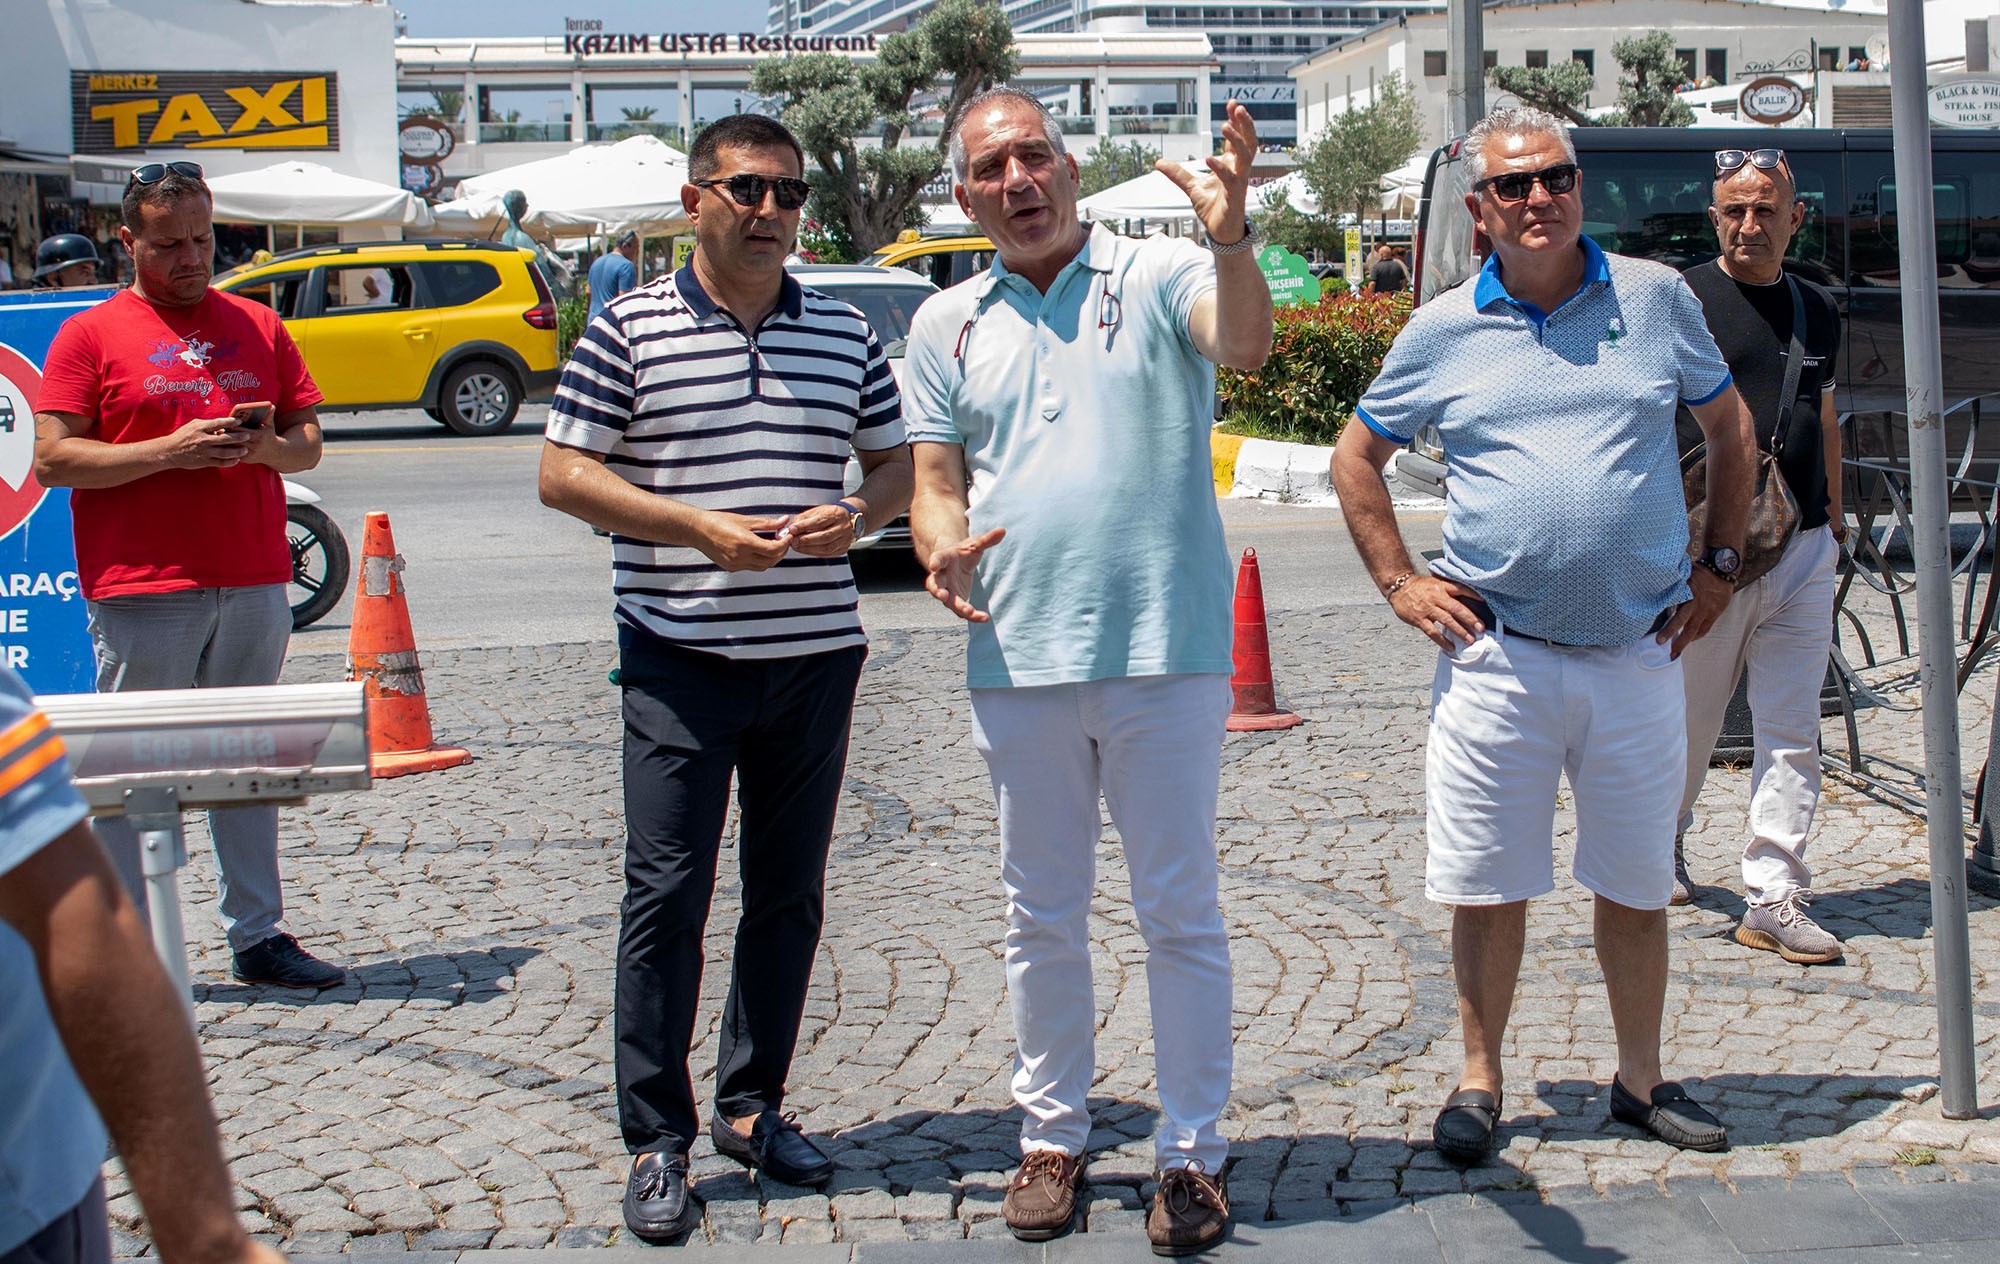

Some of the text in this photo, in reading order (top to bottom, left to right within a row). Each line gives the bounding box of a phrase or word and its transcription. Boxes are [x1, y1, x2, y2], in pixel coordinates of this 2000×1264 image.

[565, 16, 603, 31] Terrace
[564, 31, 877, 55] KAZIM USTA Restaurant
[89, 73, 159, 91] MERKEZ
[1224, 87, 1265, 100] MSC
[1936, 85, 1969, 101] BLACK
[1971, 84, 1979, 95] &
[91, 76, 328, 148] TAXI
[1944, 101, 1976, 110] STEAK
[1958, 112, 1993, 121] HOUSE
[143, 369, 261, 398] Beverly Hills
[131, 730, 192, 768] Ege
